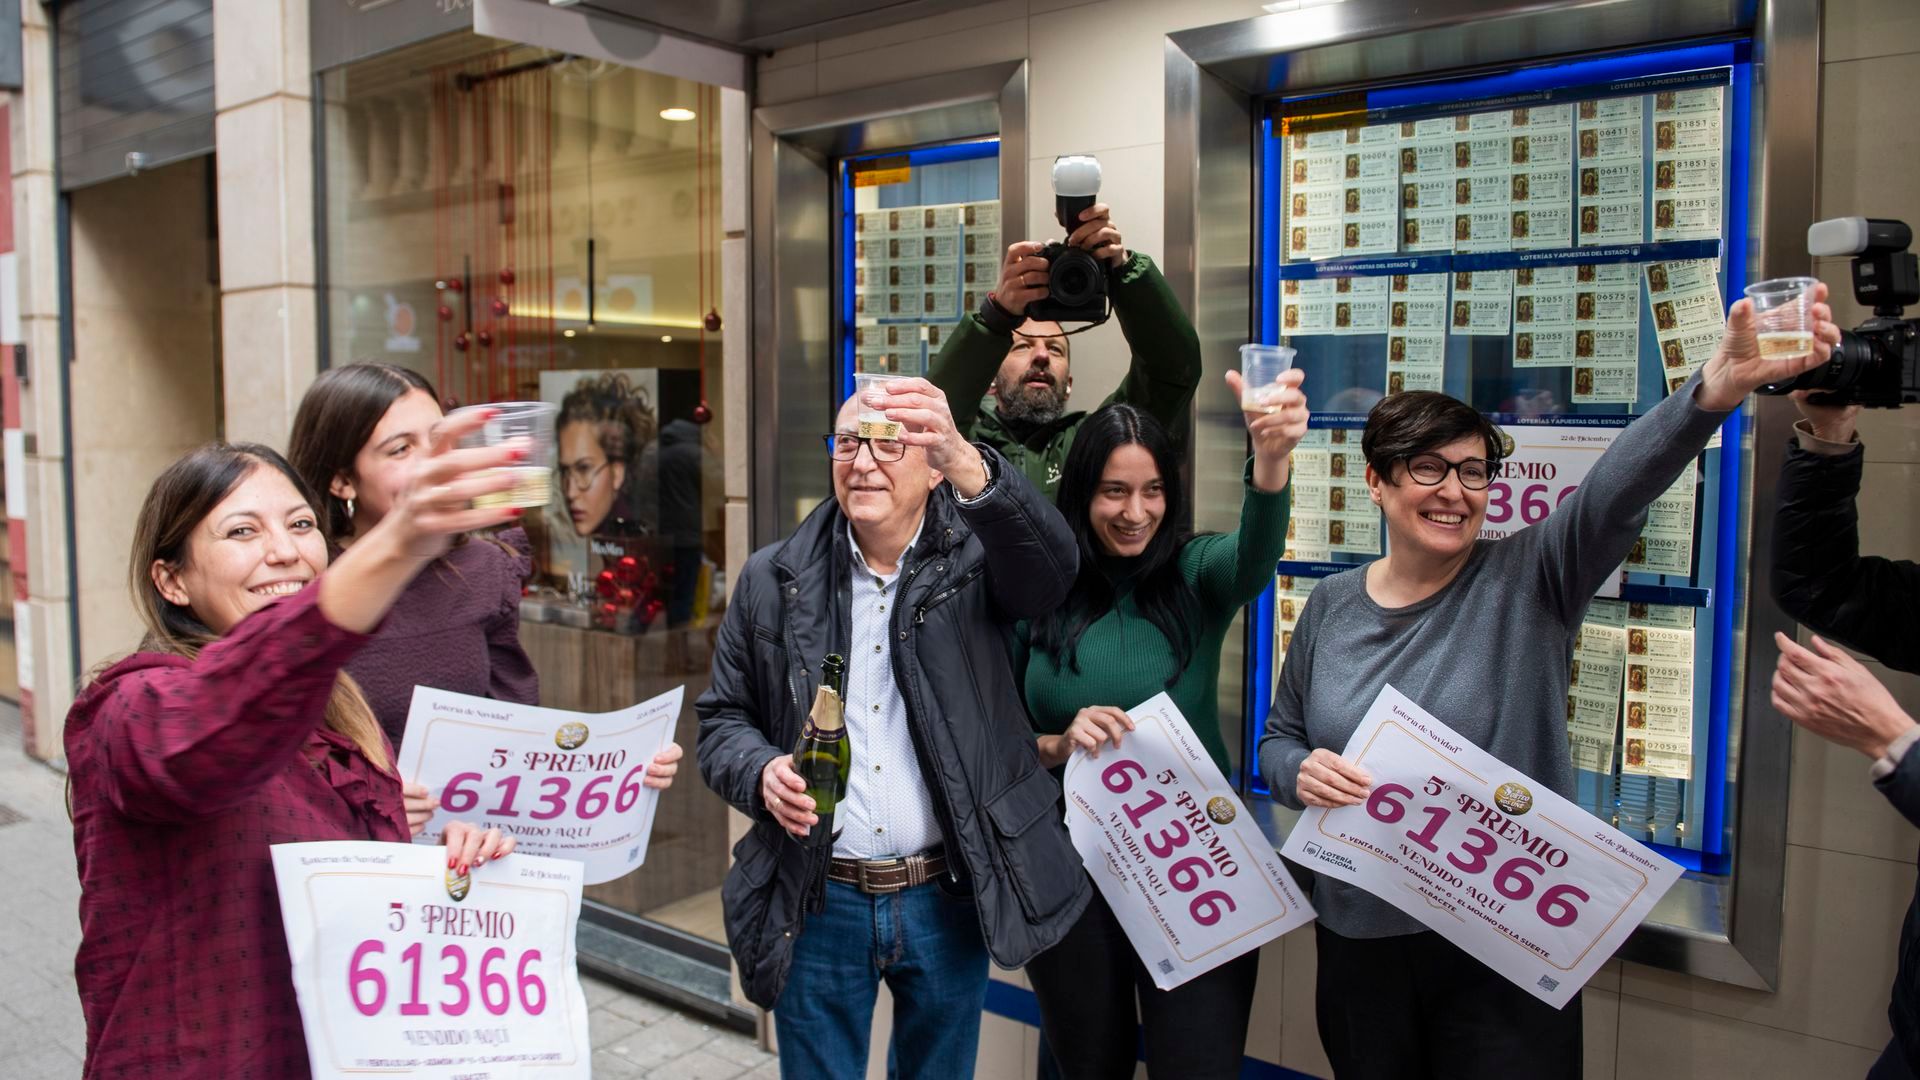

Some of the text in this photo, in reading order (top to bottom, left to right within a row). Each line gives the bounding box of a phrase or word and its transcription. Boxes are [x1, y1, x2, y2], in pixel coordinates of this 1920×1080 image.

[1519, 252, 1552, 261] LOTERÍAS
[1596, 293, 1626, 301] 06575
[1675, 296, 1706, 307] 88745
[1596, 331, 1625, 339] 06575
[1595, 369, 1624, 377] 06575
[1577, 434, 1611, 442] Diciembre
[1582, 663, 1610, 673] 10209
[1649, 667, 1679, 677] 07059
[1578, 698, 1606, 709] 10209
[1648, 705, 1678, 714] 07059
[1417, 724, 1428, 734] de
[523, 749, 626, 773] PREMIO
[440, 764, 643, 821] 61366
[1101, 759, 1237, 927] 61366
[1109, 811, 1146, 865] VENDIDO
[1174, 790, 1239, 878] PREMIO
[1456, 793, 1569, 869] PREMIO
[1319, 854, 1357, 873] NACIONAL
[1321, 850, 1353, 865] LOTERÍA
[1365, 782, 1590, 928] 61366
[1594, 831, 1661, 872] 22 de Diciembre
[1106, 851, 1128, 882] ALBACETE
[1398, 843, 1507, 914] VENDIDO AQUÍ
[1339, 832, 1347, 840] P.
[1349, 836, 1373, 850] VENTA
[1403, 864, 1434, 887] ADMÓN.
[1456, 899, 1466, 908] EL
[1466, 904, 1498, 926] MOLINO
[1497, 923, 1509, 934] DE
[1508, 929, 1519, 940] LA
[1519, 937, 1551, 959] SUERTE
[1418, 886, 1457, 913] ALBACETE
[421, 904, 515, 940] PREMIO
[1136, 880, 1154, 906] MOLINO
[1152, 905, 1161, 916] DE
[1157, 914, 1165, 924] LA
[1163, 922, 1180, 946] SUERTE
[348, 938, 547, 1017] 61366
